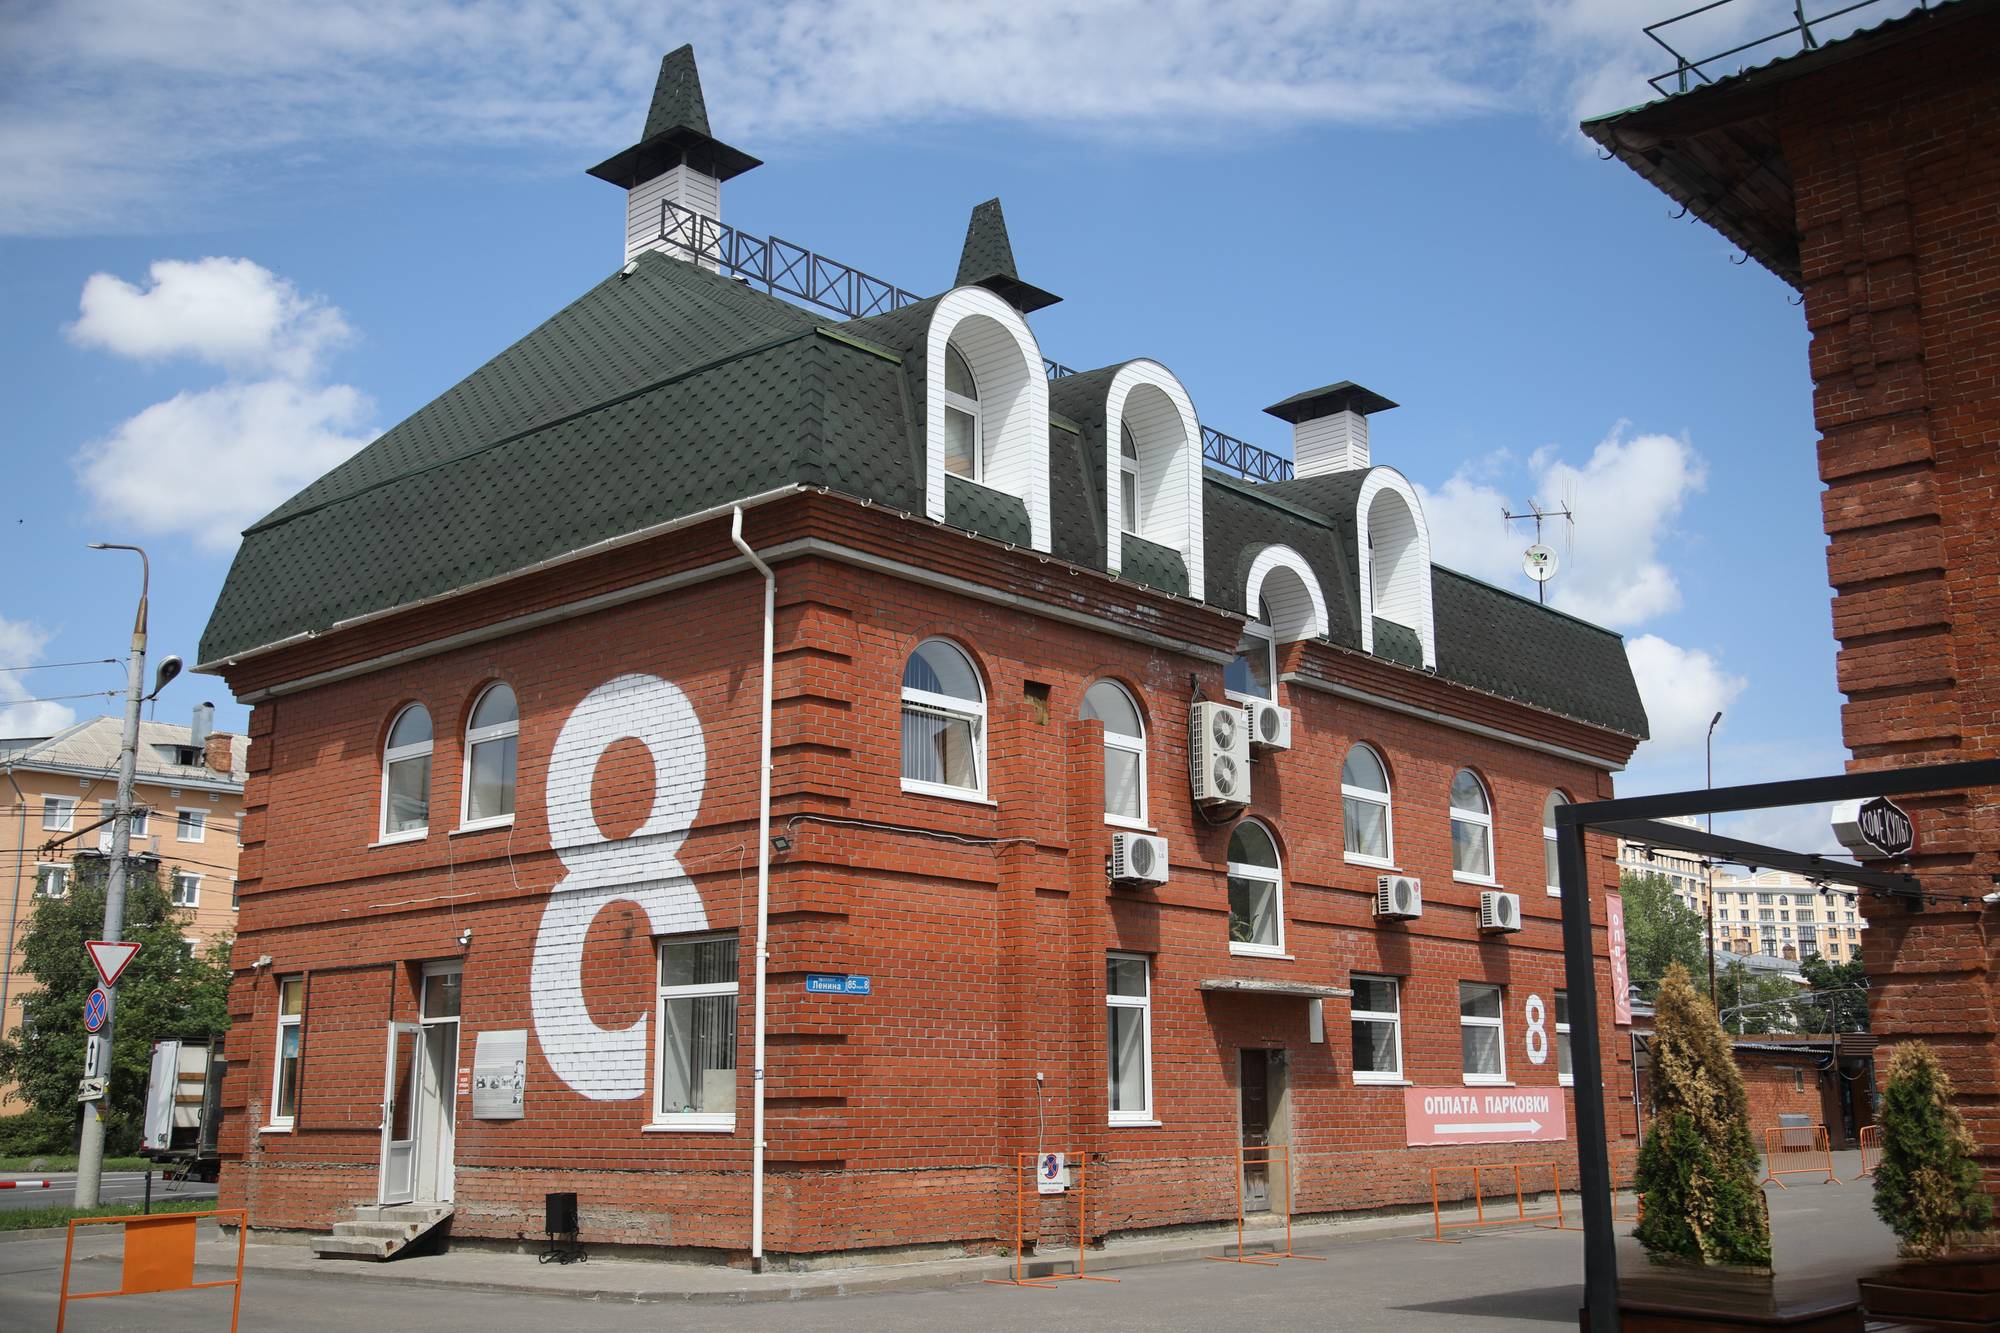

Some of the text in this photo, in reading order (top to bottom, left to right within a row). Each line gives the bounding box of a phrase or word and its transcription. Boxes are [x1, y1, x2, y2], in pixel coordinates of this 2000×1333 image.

[1862, 807, 1908, 847] КОФЕ КУЛЬТ
[1612, 912, 1625, 1006] ОПЛАТА
[812, 980, 841, 991] Ленина
[847, 980, 857, 990] 85
[1525, 994, 1547, 1065] 8
[1424, 1096, 1549, 1115] ОПЛАТА ПАРКОВКИ
